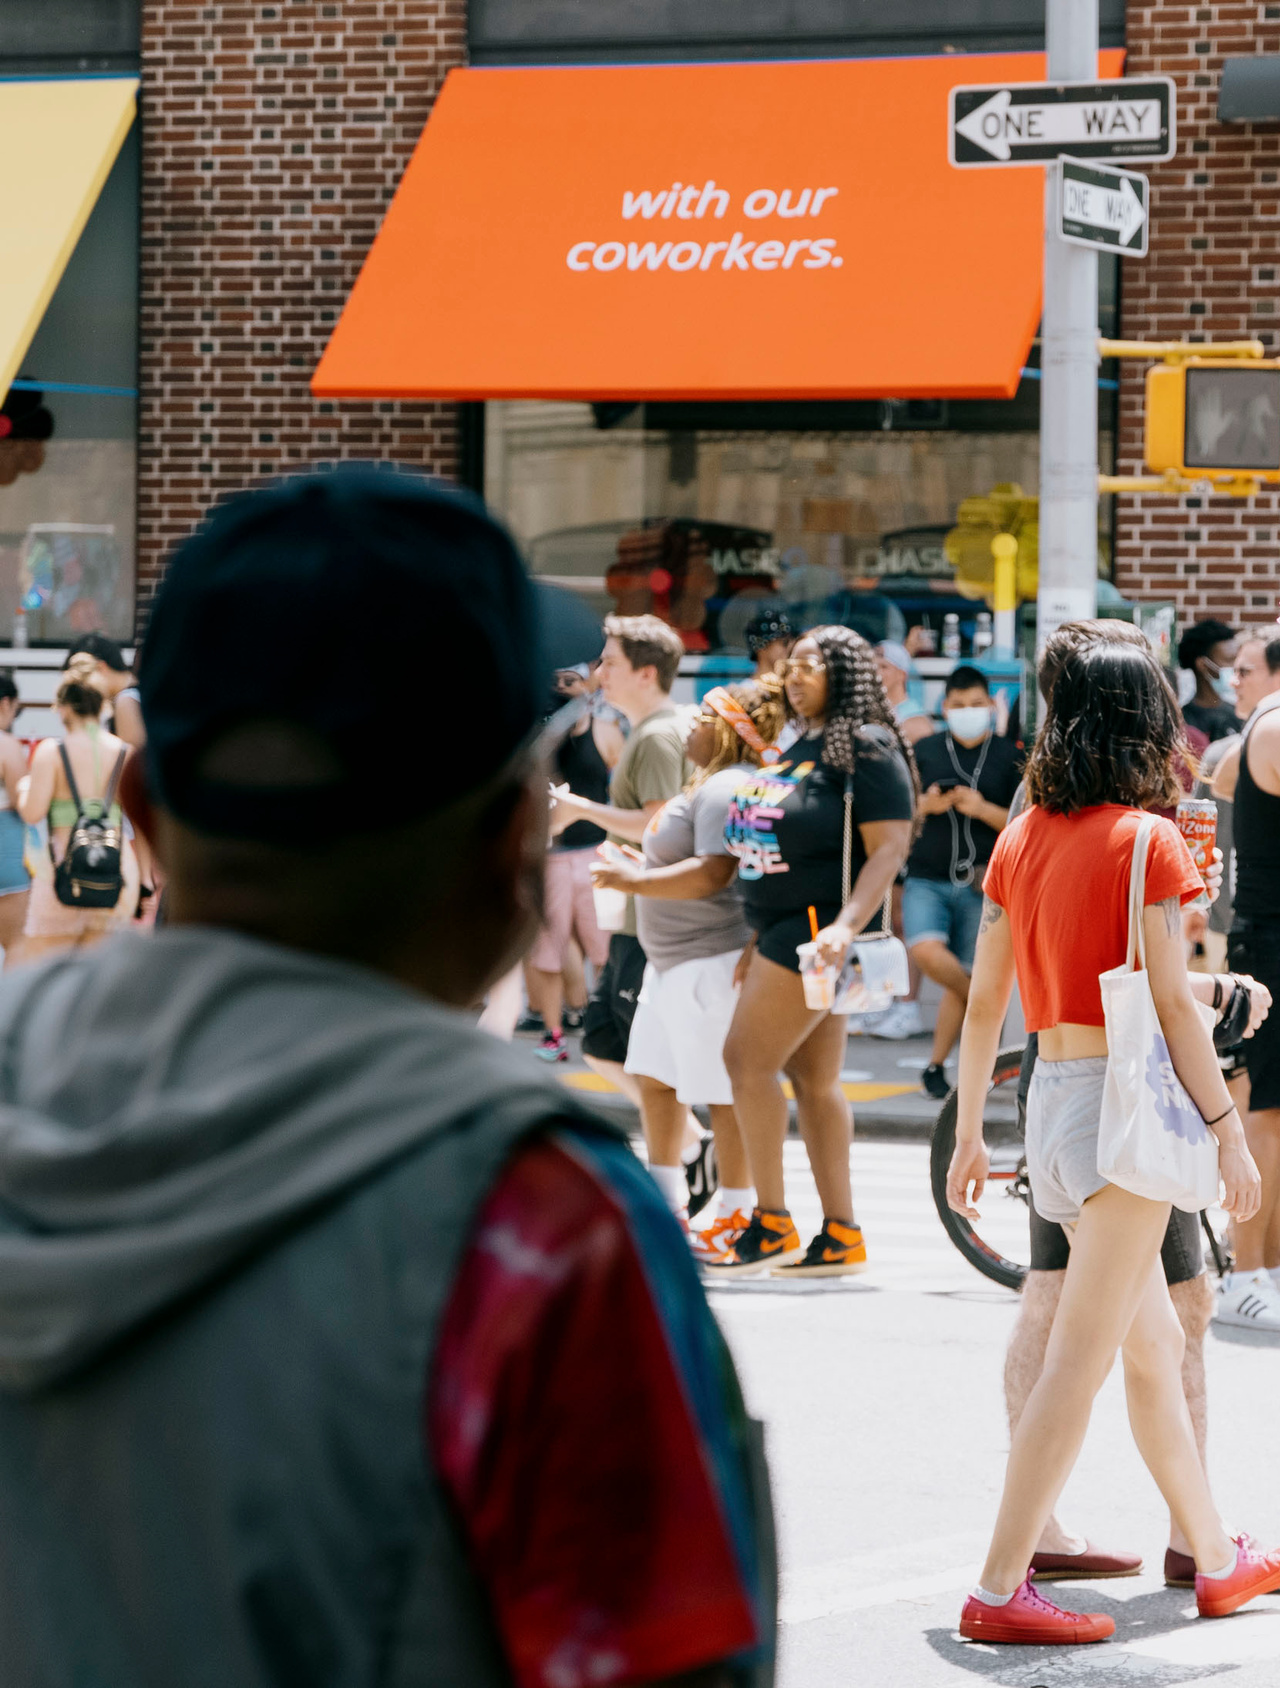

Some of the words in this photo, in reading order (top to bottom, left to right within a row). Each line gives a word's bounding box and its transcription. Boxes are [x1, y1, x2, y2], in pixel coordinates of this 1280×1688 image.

[982, 111, 1043, 140] ONE
[1083, 104, 1151, 136] WAY
[621, 180, 730, 219] with
[743, 186, 839, 219] our
[1066, 185, 1090, 218] ONE
[1105, 195, 1135, 227] WAY
[566, 232, 844, 272] coworkers.
